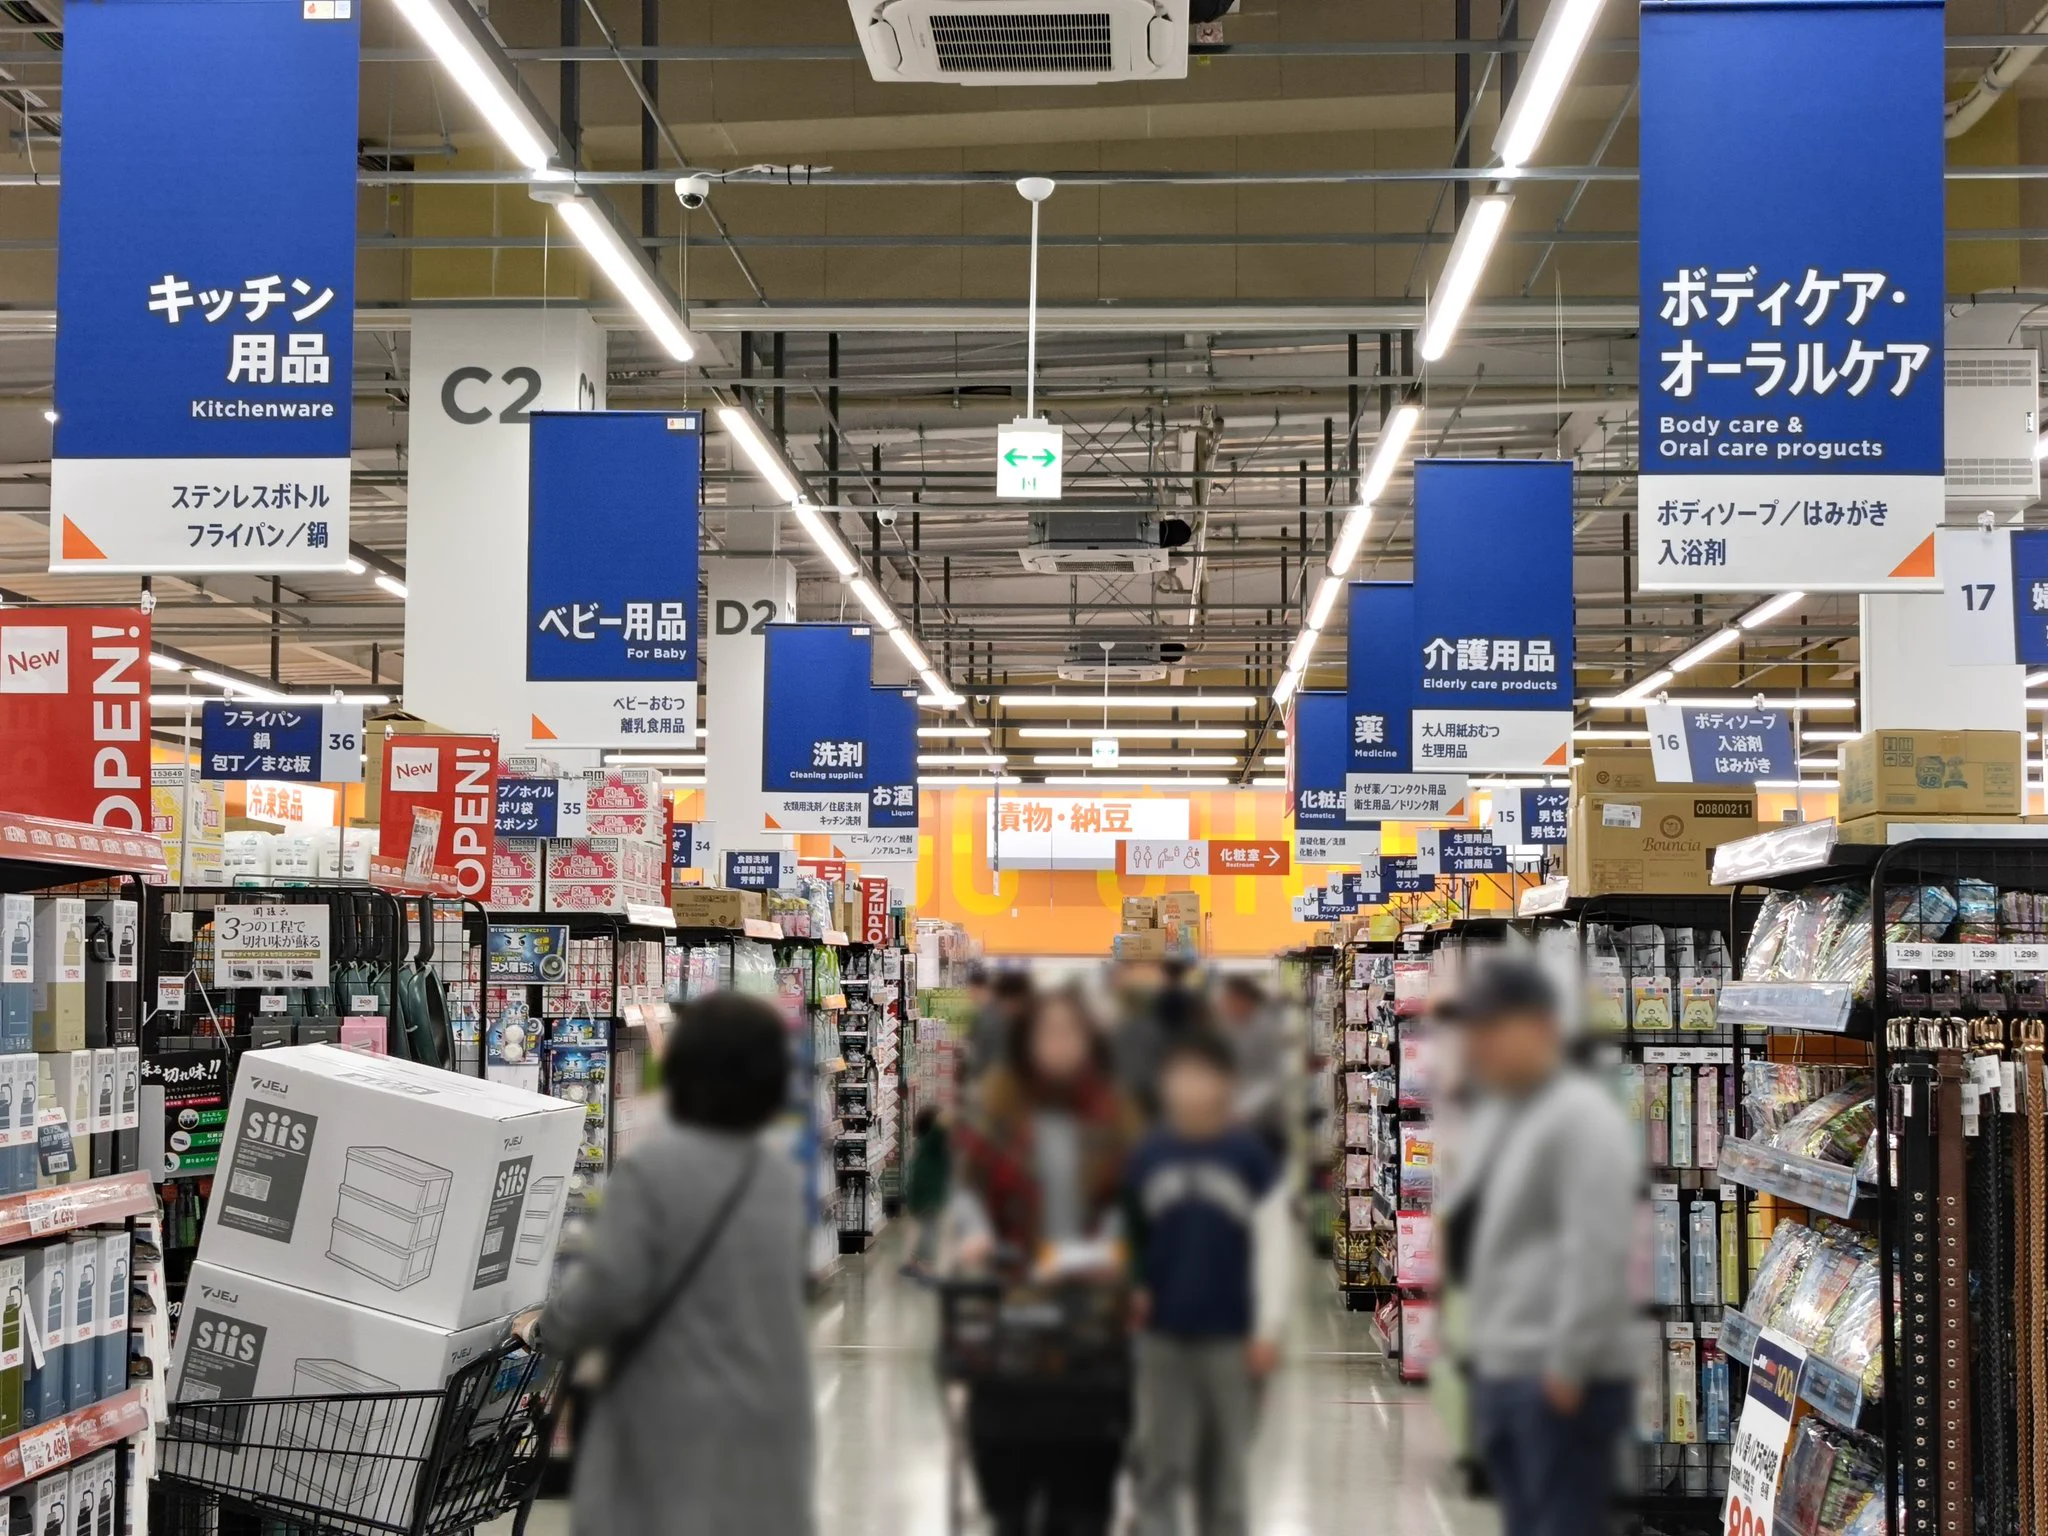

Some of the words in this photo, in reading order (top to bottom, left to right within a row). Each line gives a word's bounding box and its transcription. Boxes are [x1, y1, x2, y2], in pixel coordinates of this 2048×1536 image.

[148, 274, 334, 323] キッチン
[1659, 265, 1906, 327] ボディケア・
[226, 333, 330, 384] 用品
[1659, 339, 1930, 397] オーラルケア
[441, 366, 542, 425] C2
[191, 400, 334, 418] Kitchenware
[1659, 416, 1720, 436] Body
[1728, 418, 1779, 434] care
[1787, 416, 1803, 434] &
[1659, 439, 1709, 457] Oral
[1717, 441, 1768, 457] care
[1776, 440, 1882, 459] progucts
[171, 482, 330, 509] ステンレスボトル
[187, 521, 329, 548] フライパン／鍋
[1656, 538, 1726, 566] 入浴剤
[1961, 583, 1996, 611] 17
[538, 602, 686, 641] ベビー用品
[716, 599, 777, 635] D2
[7, 649, 60, 675] New
[627, 648, 650, 659] For
[653, 648, 687, 660] Baby
[1423, 638, 1555, 672] 介護用品
[1423, 678, 1467, 690] Elderly
[1471, 681, 1498, 690] care
[1501, 680, 1558, 691] products
[613, 696, 685, 711] ベビーおむつ
[224, 710, 301, 727] フライパン
[620, 717, 685, 734] 離乳食用品
[1695, 712, 1776, 730] ボディソープ
[1354, 715, 1384, 744] 薬
[1421, 723, 1500, 738] 大人用紙おむつ
[253, 732, 271, 750] 鍋
[328, 733, 355, 750] 36
[1657, 734, 1680, 751] 16
[1718, 735, 1763, 753] 入浴剤
[813, 741, 863, 767] 洗剤
[1354, 749, 1398, 757] Medicine
[1421, 743, 1468, 759] 生理用品
[396, 762, 433, 779] New
[1715, 757, 1771, 774] はみがき
[790, 771, 826, 780] Cleaning
[828, 771, 863, 780] supplies
[250, 783, 304, 822] 冷凍食品
[872, 785, 914, 807] お酒
[497, 802, 534, 815] ポリ袋
[563, 802, 581, 815] 35
[1498, 811, 1515, 823] 15
[1539, 809, 1569, 823] 男性
[1696, 802, 1750, 815] Q0800211
[453, 747, 491, 896] OPEN!
[819, 816, 862, 826] キッチン洗剤
[695, 841, 710, 851] 34
[1453, 833, 1492, 844] 生理用品
[737, 855, 769, 864] 食器洗剤
[871, 847, 913, 855] ノンアルコール
[1220, 848, 1260, 862] 化粧室
[1299, 849, 1326, 857] 化粧小物
[1421, 847, 1435, 856] 14
[1444, 846, 1502, 857] 大人用おむつ
[732, 865, 773, 875] 住居用洗剤
[782, 866, 794, 874] 33
[1454, 859, 1493, 869] 介護用品
[740, 876, 765, 885] 芳香剤
[1396, 881, 1419, 889] マスク
[867, 882, 885, 944] OPEN!
[221, 917, 306, 940] 3つの工程で
[242, 934, 320, 948] 切れ味が蘇る
